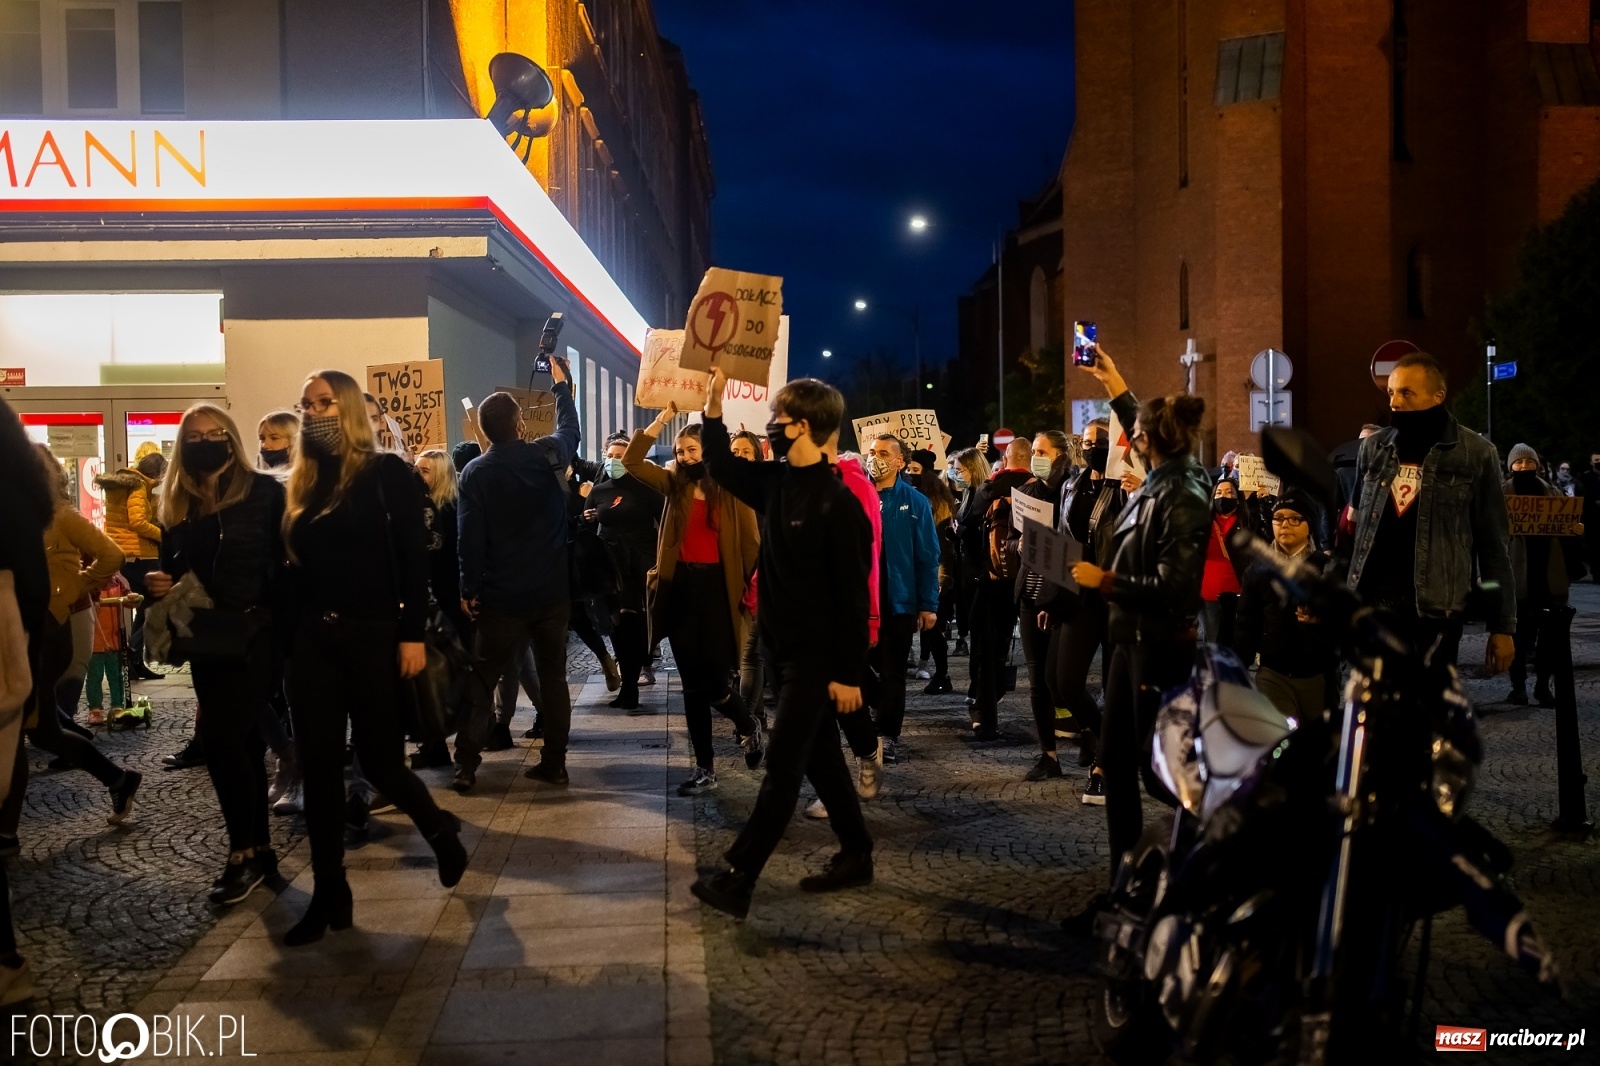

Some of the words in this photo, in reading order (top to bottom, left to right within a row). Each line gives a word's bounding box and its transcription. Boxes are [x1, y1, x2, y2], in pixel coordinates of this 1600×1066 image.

[735, 288, 778, 307] DOŁĄCZ
[745, 319, 764, 334] DO
[373, 365, 423, 394] TWÓJ
[379, 391, 412, 414] BÓL
[414, 390, 443, 410] JEST
[900, 414, 937, 427] PRECZ
[1547, 514, 1579, 523] RAZEM
[1514, 524, 1534, 534] DLA
[1538, 524, 1566, 534] SIEBIE
